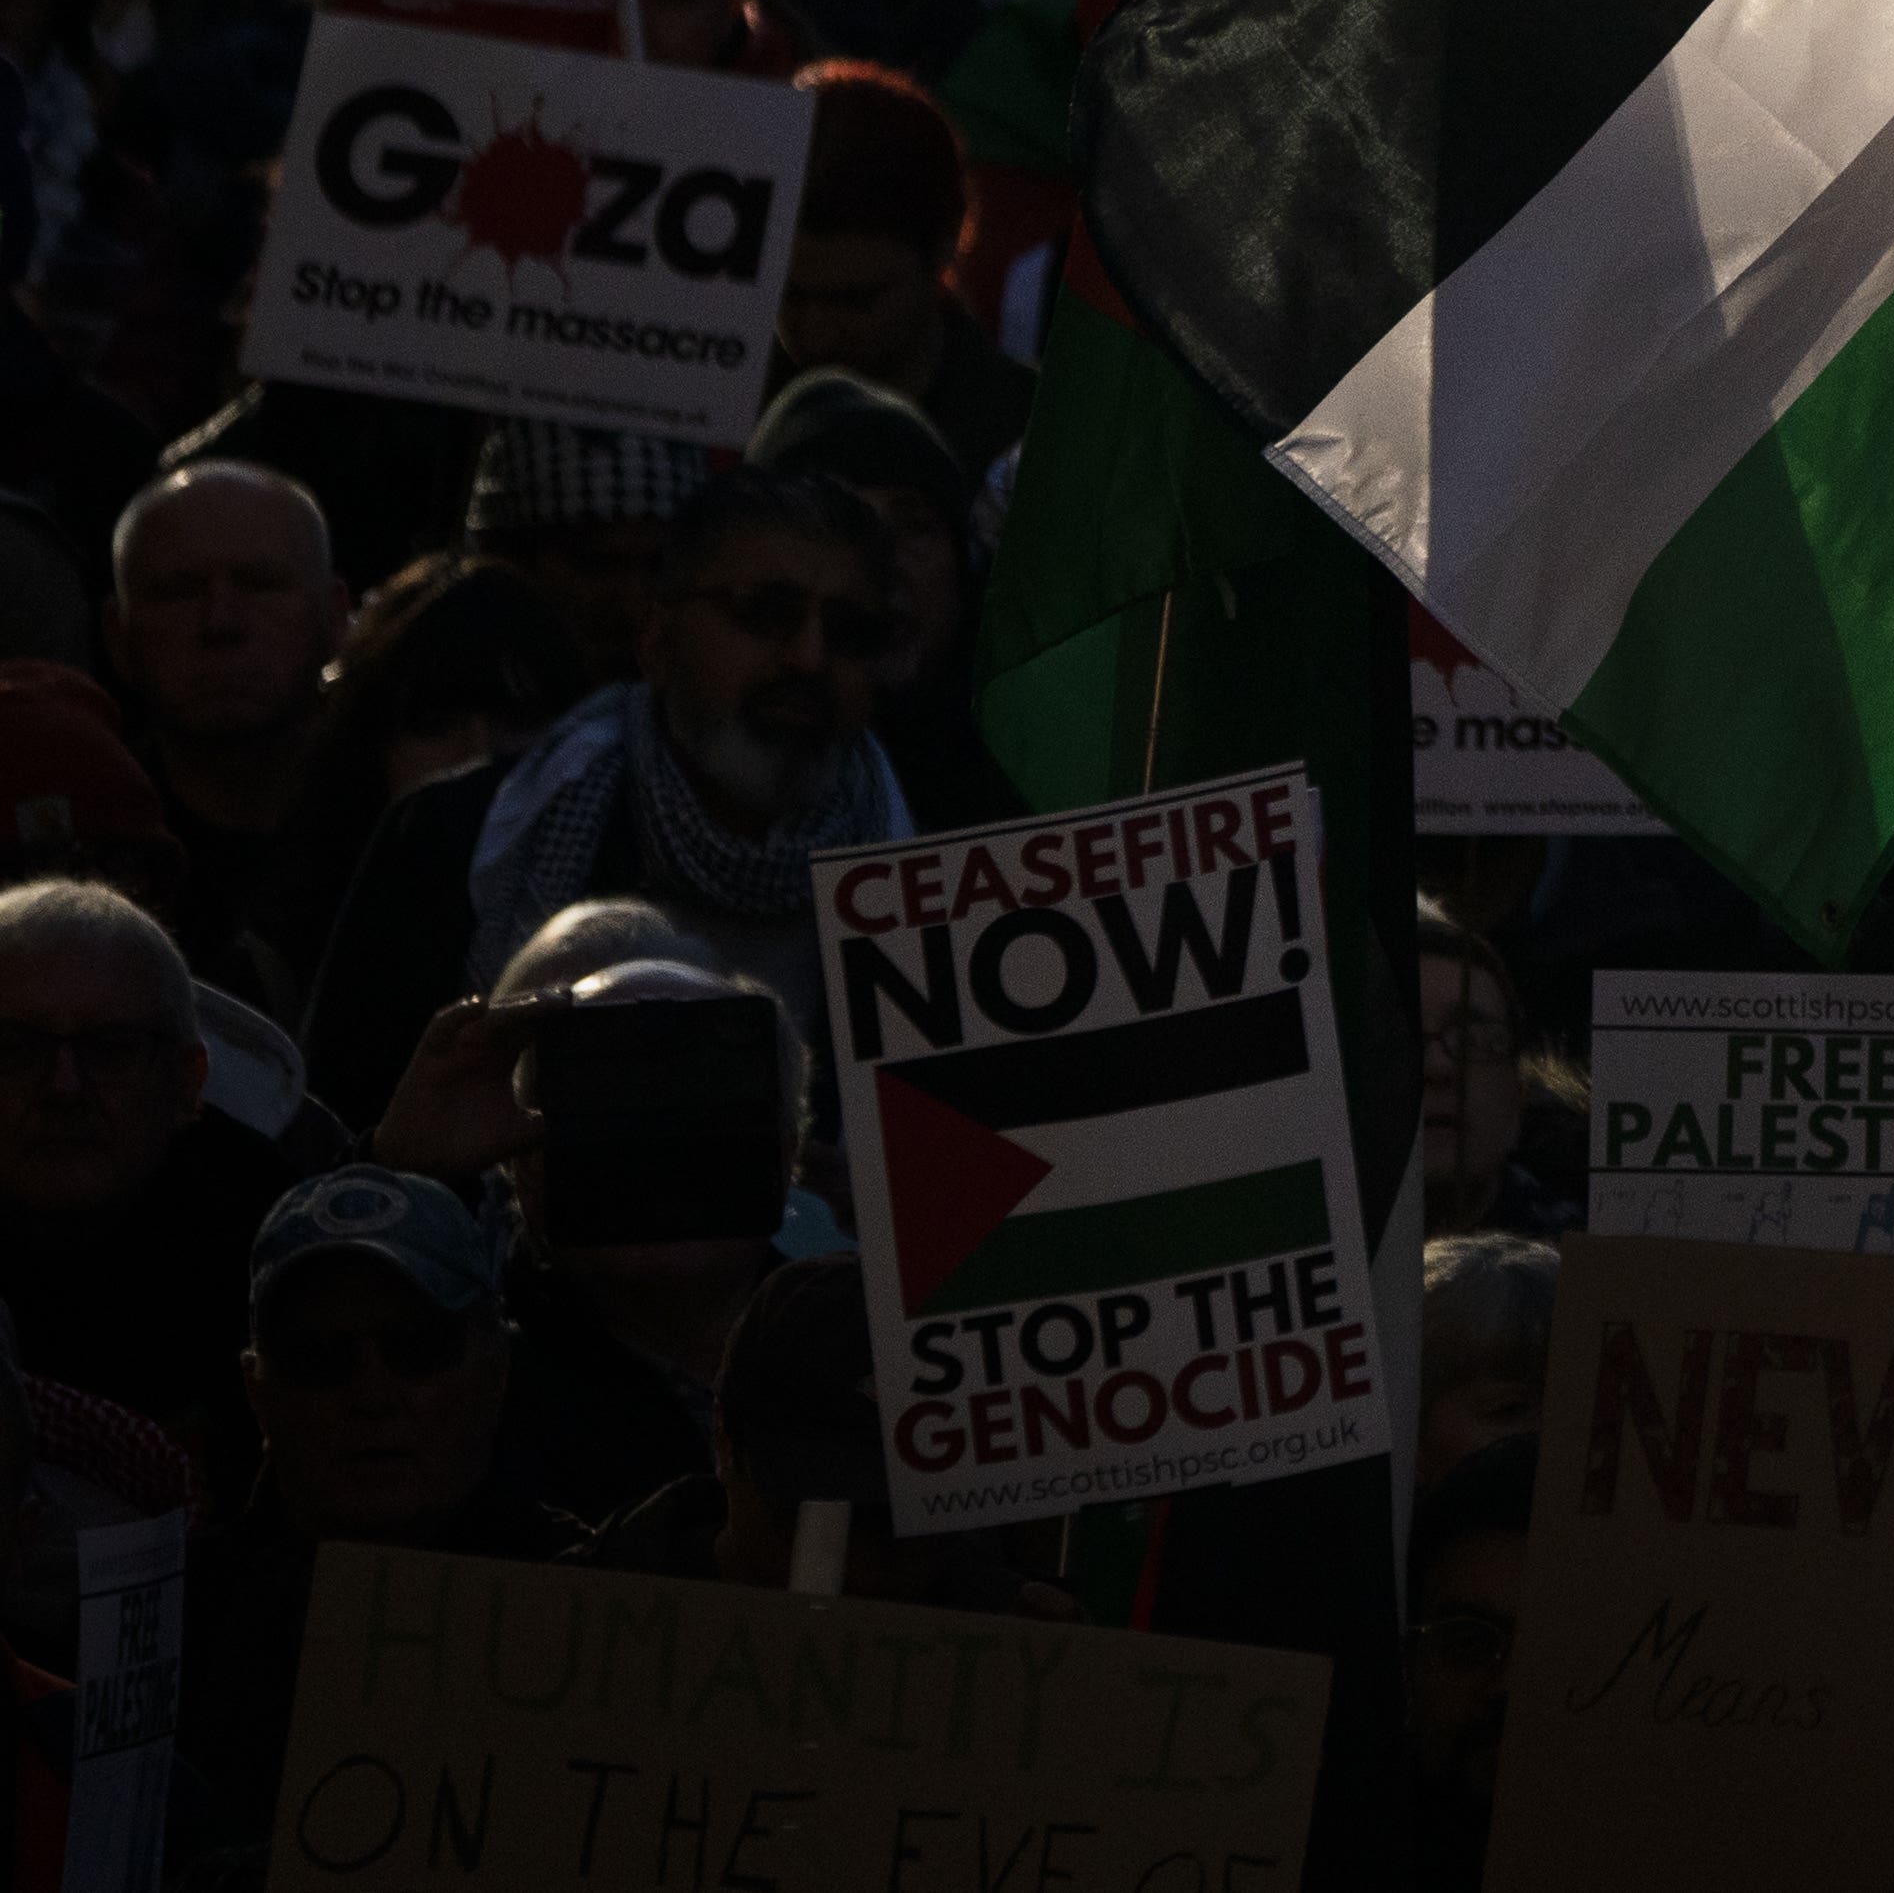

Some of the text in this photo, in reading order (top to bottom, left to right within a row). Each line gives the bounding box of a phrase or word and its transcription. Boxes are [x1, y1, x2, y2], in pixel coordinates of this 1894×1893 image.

[317, 86, 774, 284] Gza
[292, 256, 747, 374] Stop the massacre
[834, 784, 1299, 933] CEASEFIRE
[840, 846, 1314, 1062] NOW!
[893, 1320, 1373, 1473] GENOCIDE
[911, 1250, 1343, 1396] STOP THE
[922, 1415, 1363, 1517] www.scottishpsc.org.uk
[360, 1556, 1299, 1794] HUMANITY IS
[1564, 1590, 1834, 1731] Means
[296, 1752, 497, 1874] ON
[567, 1756, 819, 1893] THE
